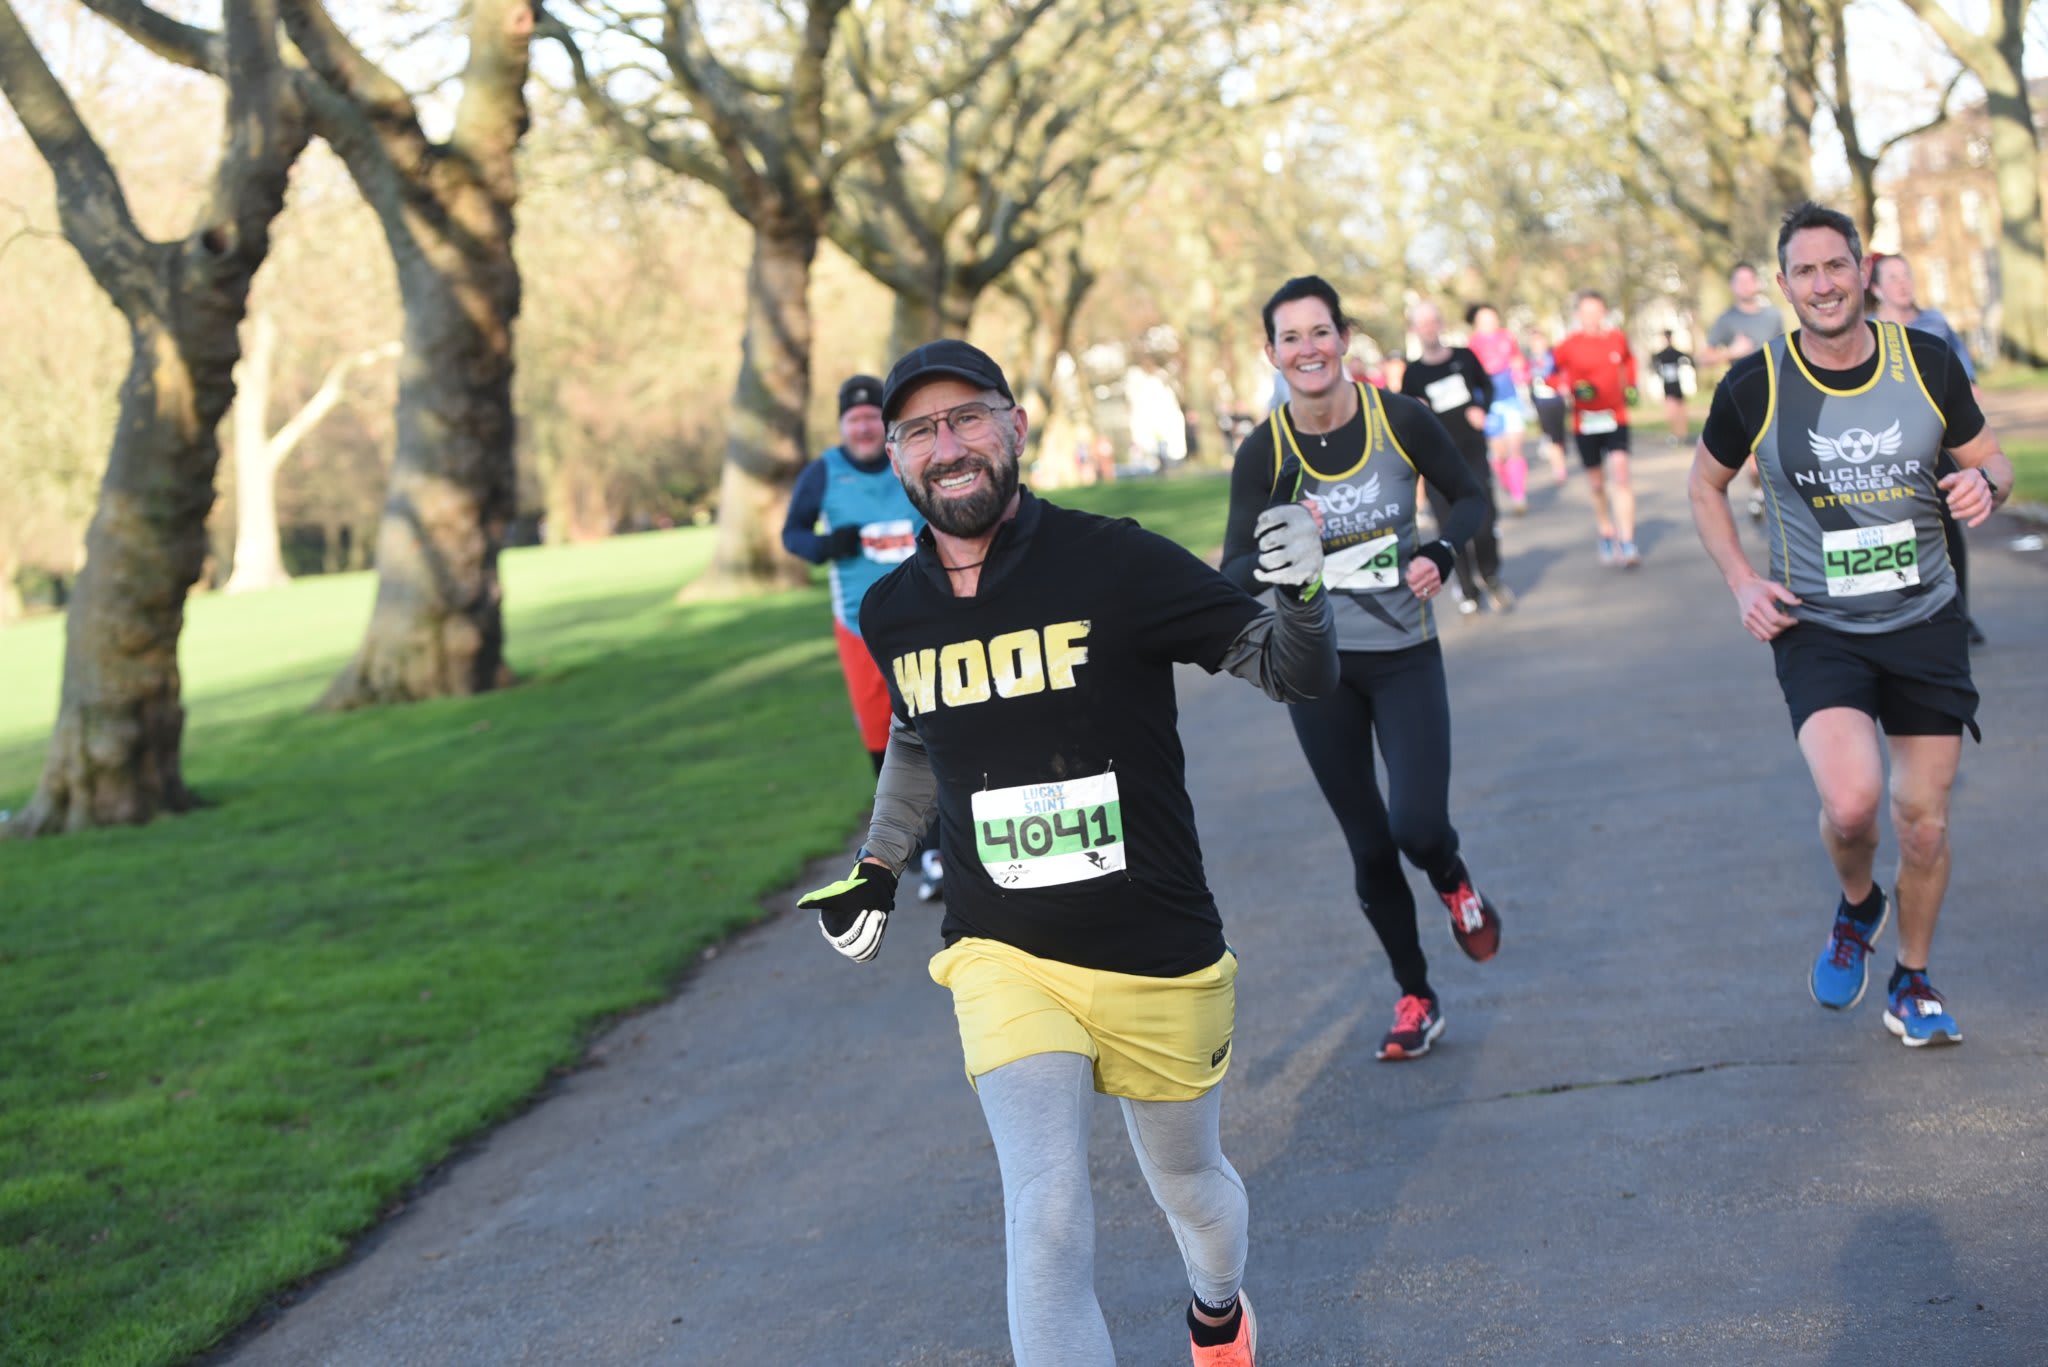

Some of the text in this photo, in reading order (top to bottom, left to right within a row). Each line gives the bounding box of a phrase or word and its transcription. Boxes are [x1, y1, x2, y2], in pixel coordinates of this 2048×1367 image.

[1795, 460, 1919, 486] NUCLEAR
[1829, 476, 1894, 492] RACES
[1812, 485, 1916, 508] STRIDERS
[1322, 503, 1400, 532] CLEAR
[1827, 541, 1914, 575] 4226
[892, 619, 1091, 718] WOOF
[1023, 784, 1065, 801] LUCKY
[1024, 796, 1066, 814] SAINT
[983, 805, 1116, 859] 4041
